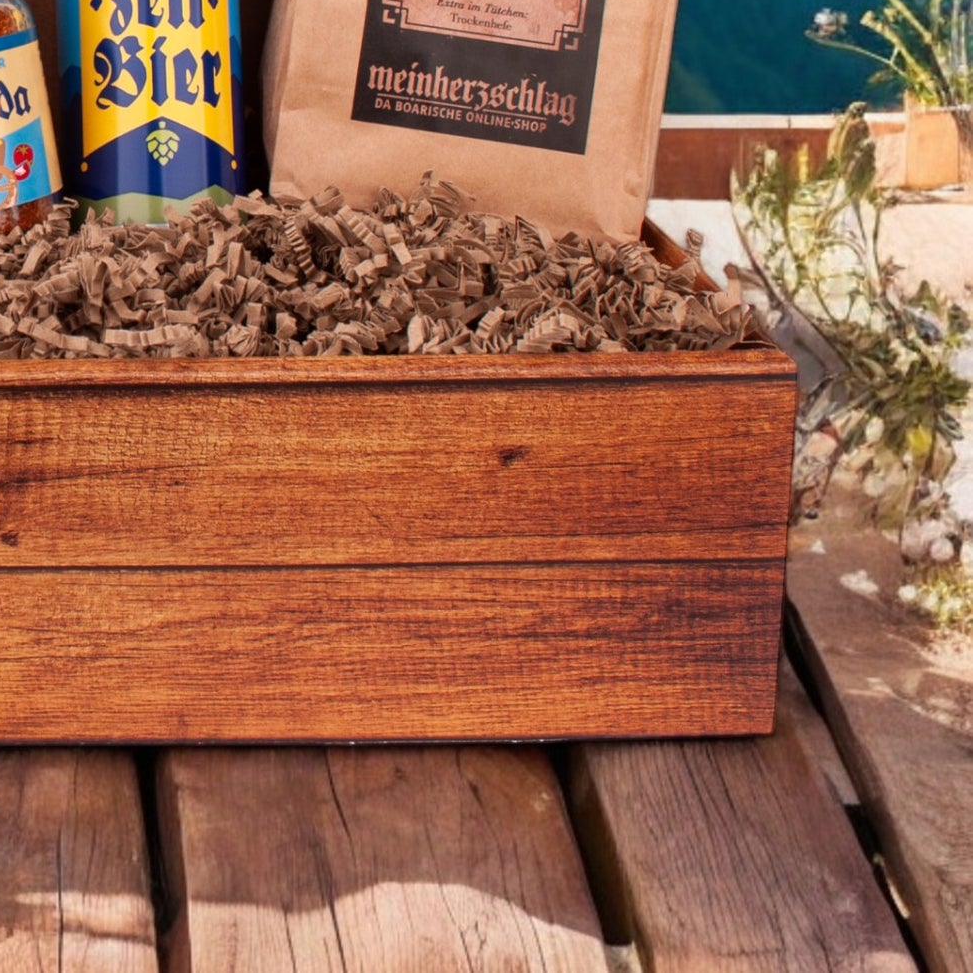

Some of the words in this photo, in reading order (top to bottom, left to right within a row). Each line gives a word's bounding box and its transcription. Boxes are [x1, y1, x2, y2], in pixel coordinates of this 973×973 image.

[450, 12, 513, 30] Trockenhefe
[467, 1, 481, 12] im
[484, 3, 529, 19] Tütchen:
[93, 35, 222, 111] Bier
[367, 62, 577, 126] meinherzschlag
[375, 98, 391, 110] DA
[395, 102, 462, 121] BOARISCHE
